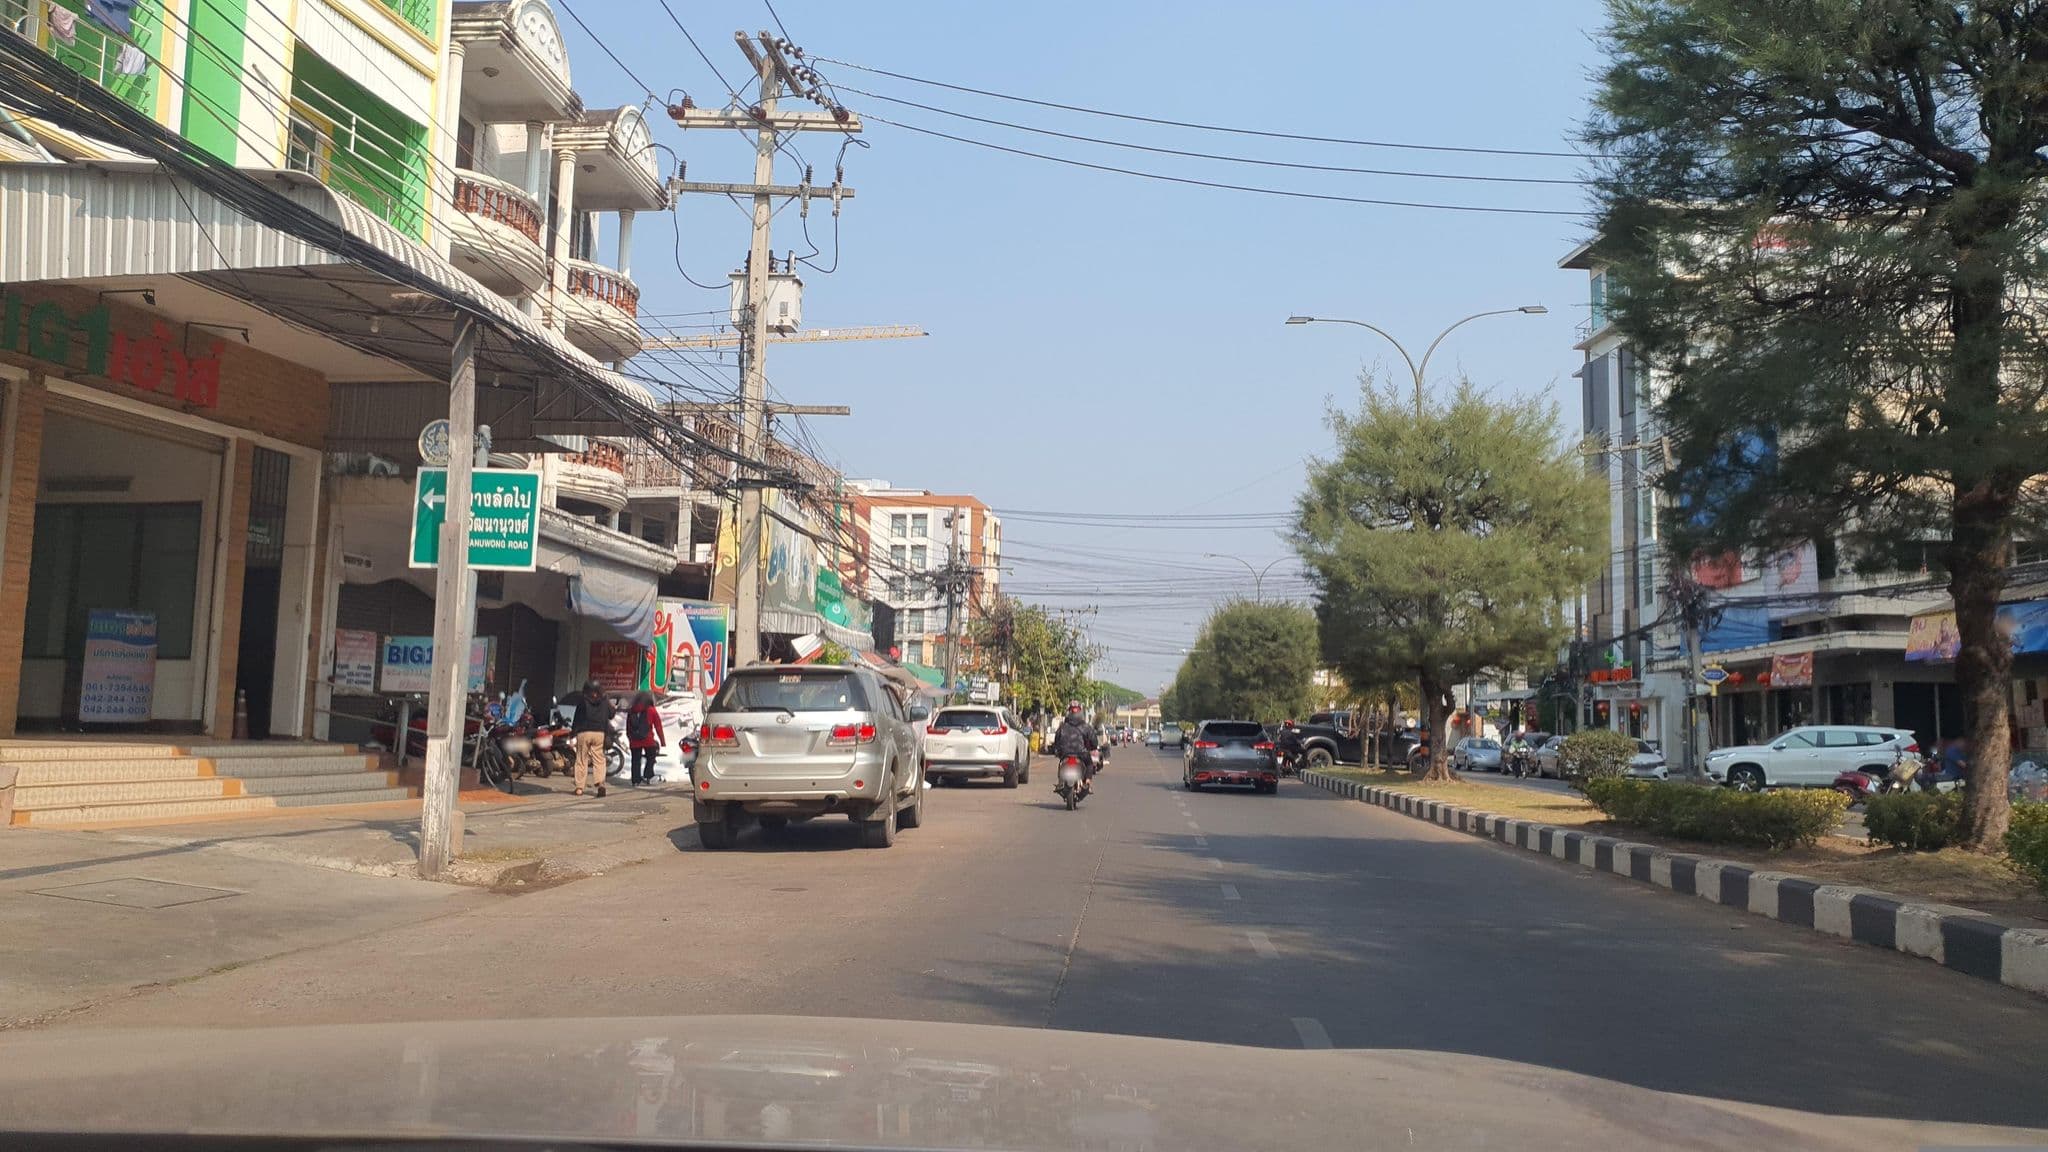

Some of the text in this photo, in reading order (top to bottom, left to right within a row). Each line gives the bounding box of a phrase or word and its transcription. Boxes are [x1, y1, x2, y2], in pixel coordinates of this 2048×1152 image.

[0, 293, 108, 376] IG1
[471, 486, 531, 508] างลัดไป
[470, 539, 528, 549] ANUWONG ROAD
